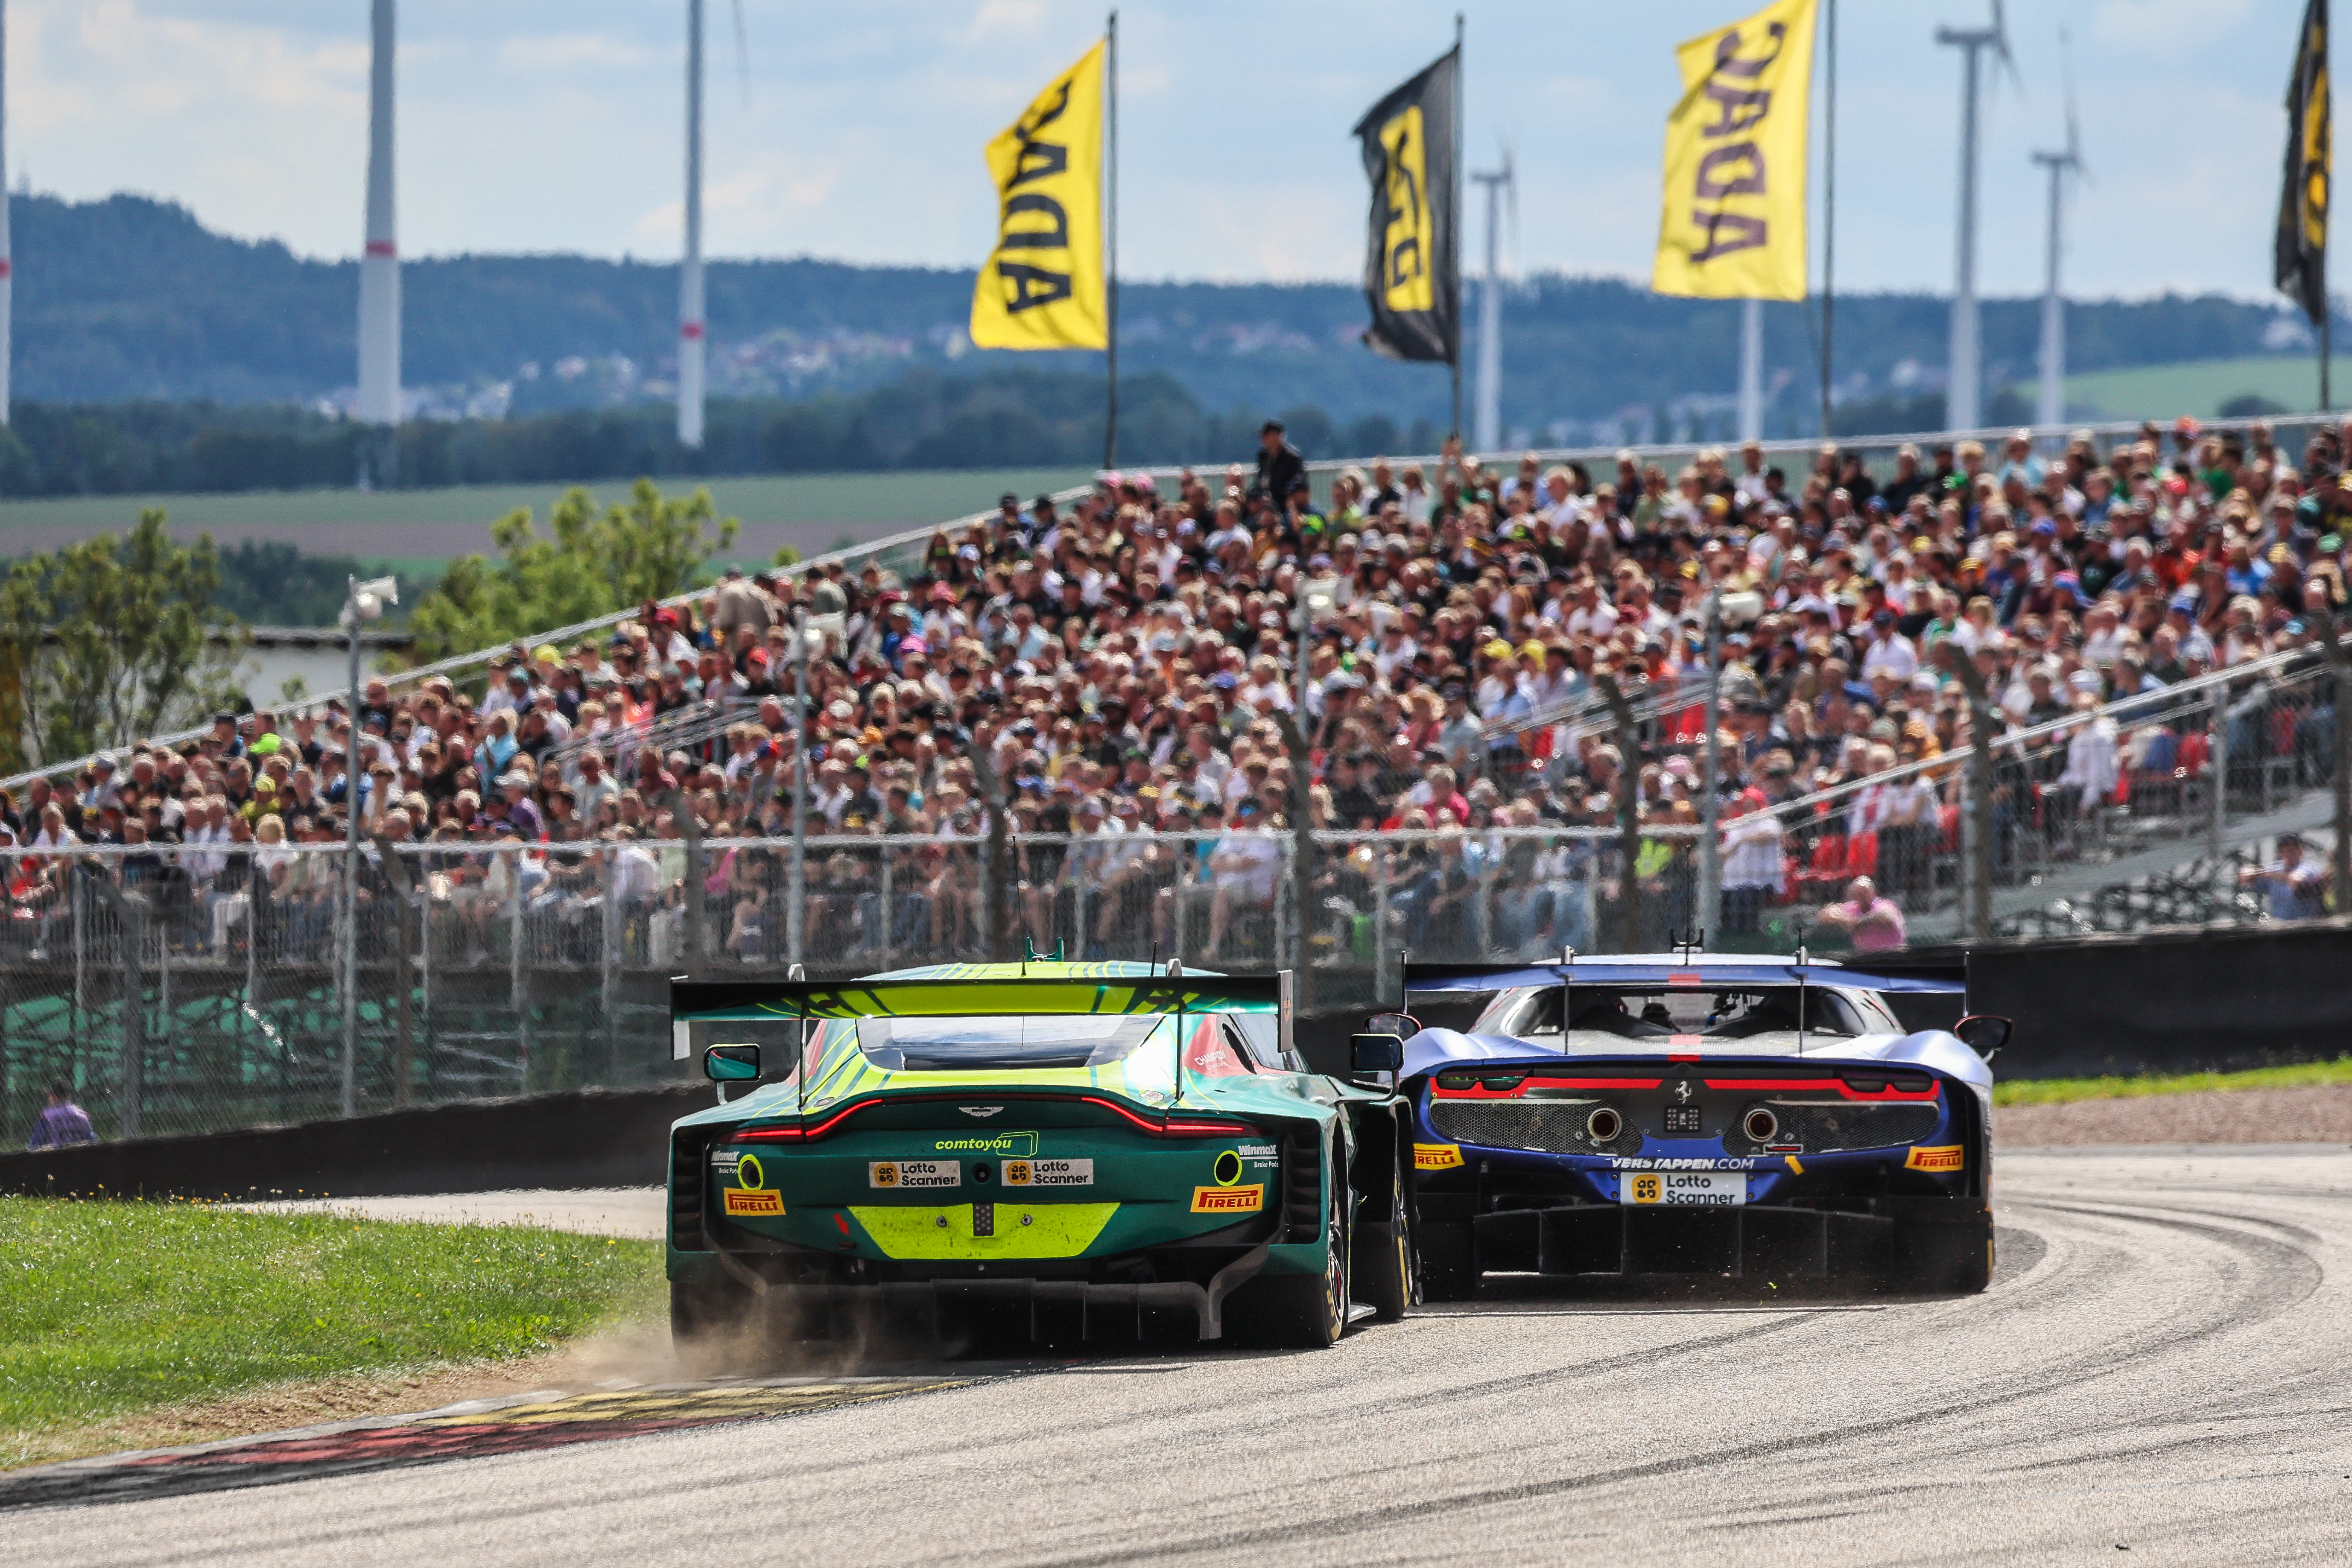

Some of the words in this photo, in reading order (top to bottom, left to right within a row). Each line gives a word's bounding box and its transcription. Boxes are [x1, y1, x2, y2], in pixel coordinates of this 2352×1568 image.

[1194, 1050, 1227, 1066] CHAMPION
[935, 1139, 1011, 1151] comtoyou
[1611, 1158, 1755, 1170] VERSTAPPEN.COM
[1913, 1150, 1960, 1166] PIRELLI
[901, 1163, 936, 1174] Lotto
[1034, 1162, 1069, 1172] Lotto
[902, 1175, 956, 1186] Scanner
[1034, 1174, 1089, 1183] Scanner
[1667, 1175, 1711, 1188] Lotto
[728, 1194, 778, 1211] PIRELLI
[1198, 1190, 1258, 1207] PIRELLI
[1667, 1191, 1735, 1205] Scanner
